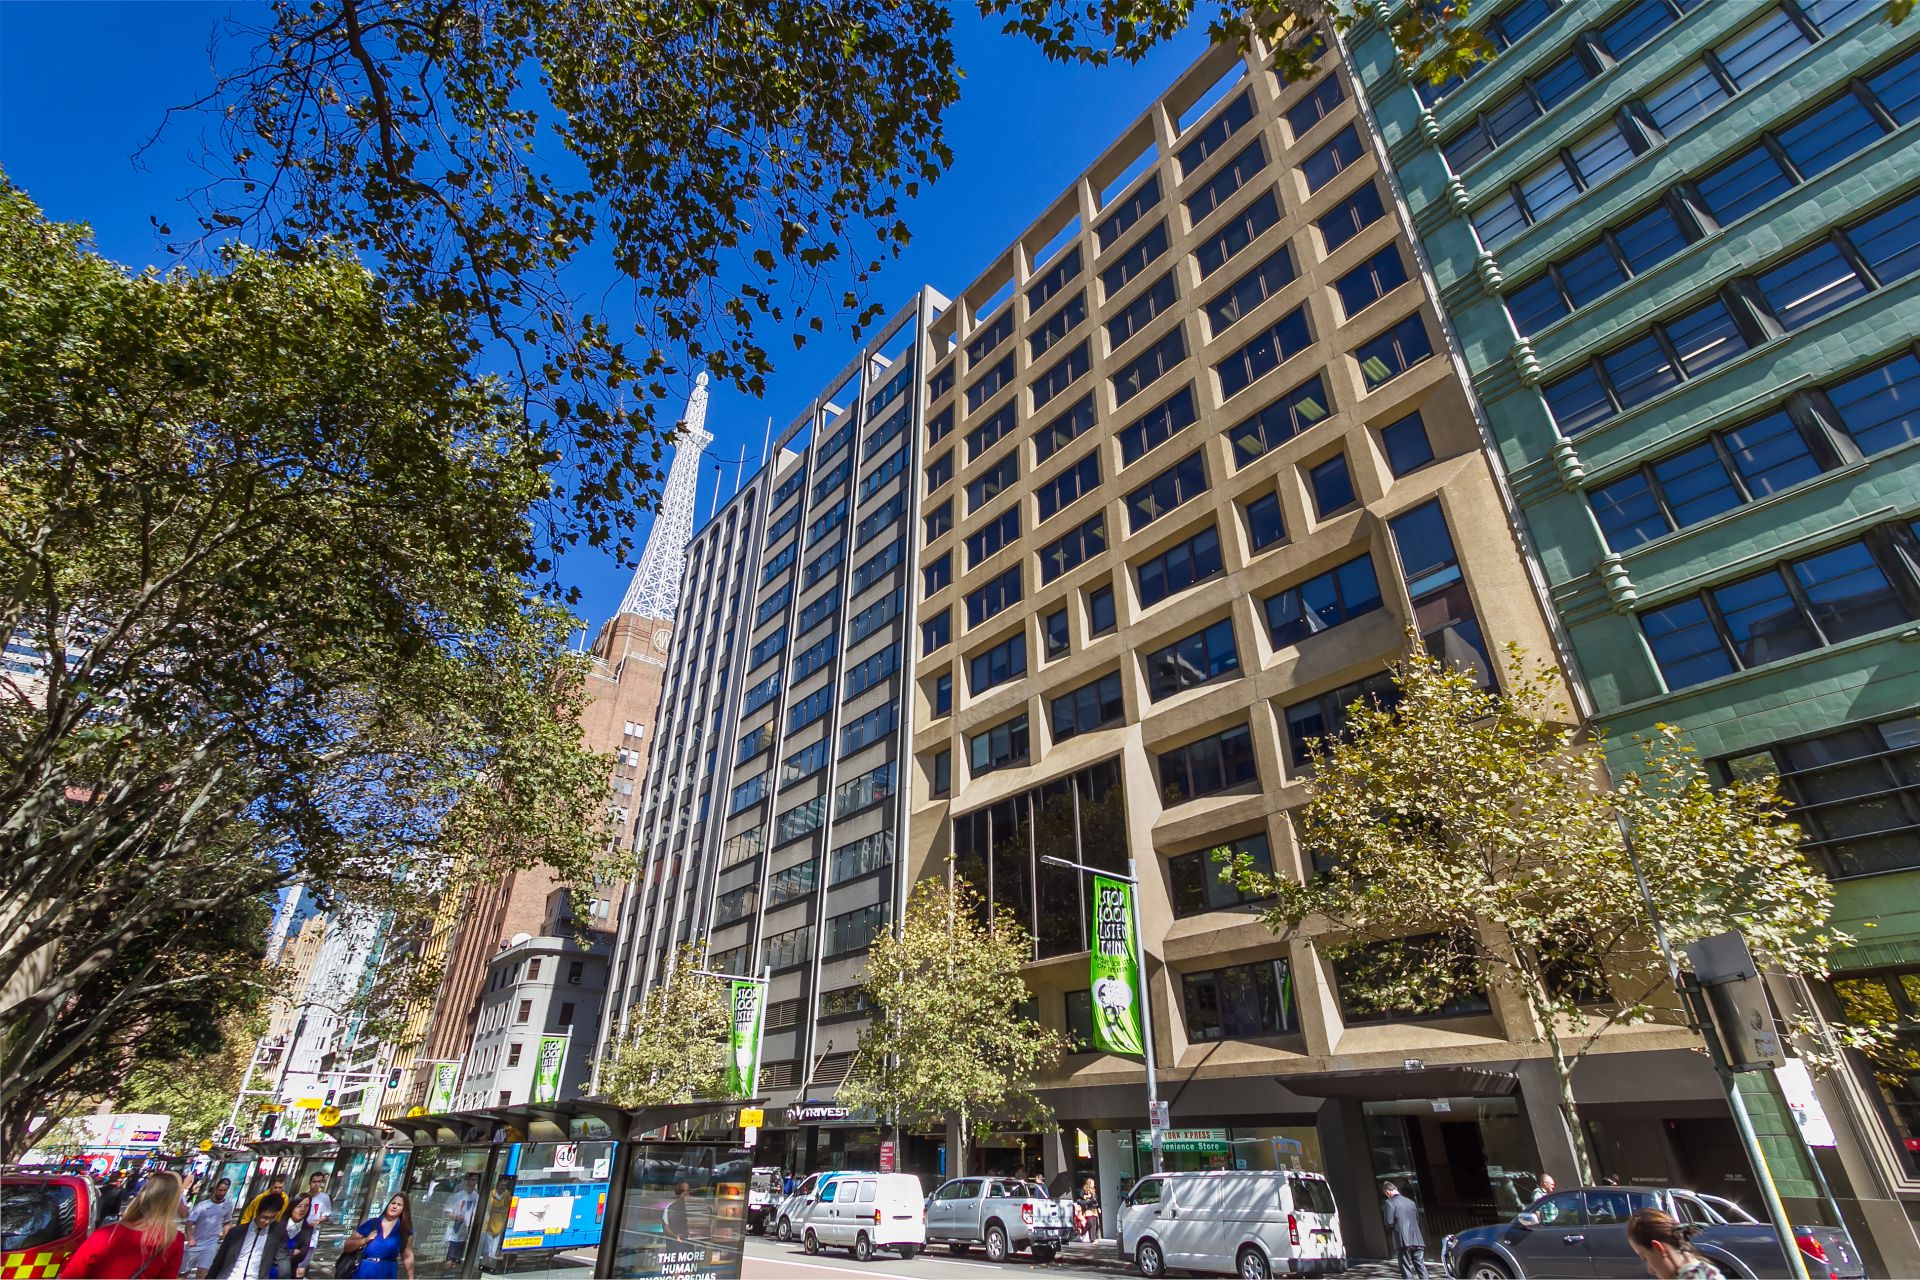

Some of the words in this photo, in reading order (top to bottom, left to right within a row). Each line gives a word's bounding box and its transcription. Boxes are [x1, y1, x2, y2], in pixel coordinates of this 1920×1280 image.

[1102, 890, 1124, 906] STOP
[1099, 923, 1127, 940] LISTEN
[1100, 941, 1129, 956] THINK
[1149, 1142, 1195, 1151] Cvenience
[1198, 1142, 1220, 1150] Store
[658, 1252, 676, 1263] THE
[678, 1251, 705, 1262] MORE
[662, 1263, 698, 1275] HUMAN
[640, 1272, 717, 1280] OPEDIAS
